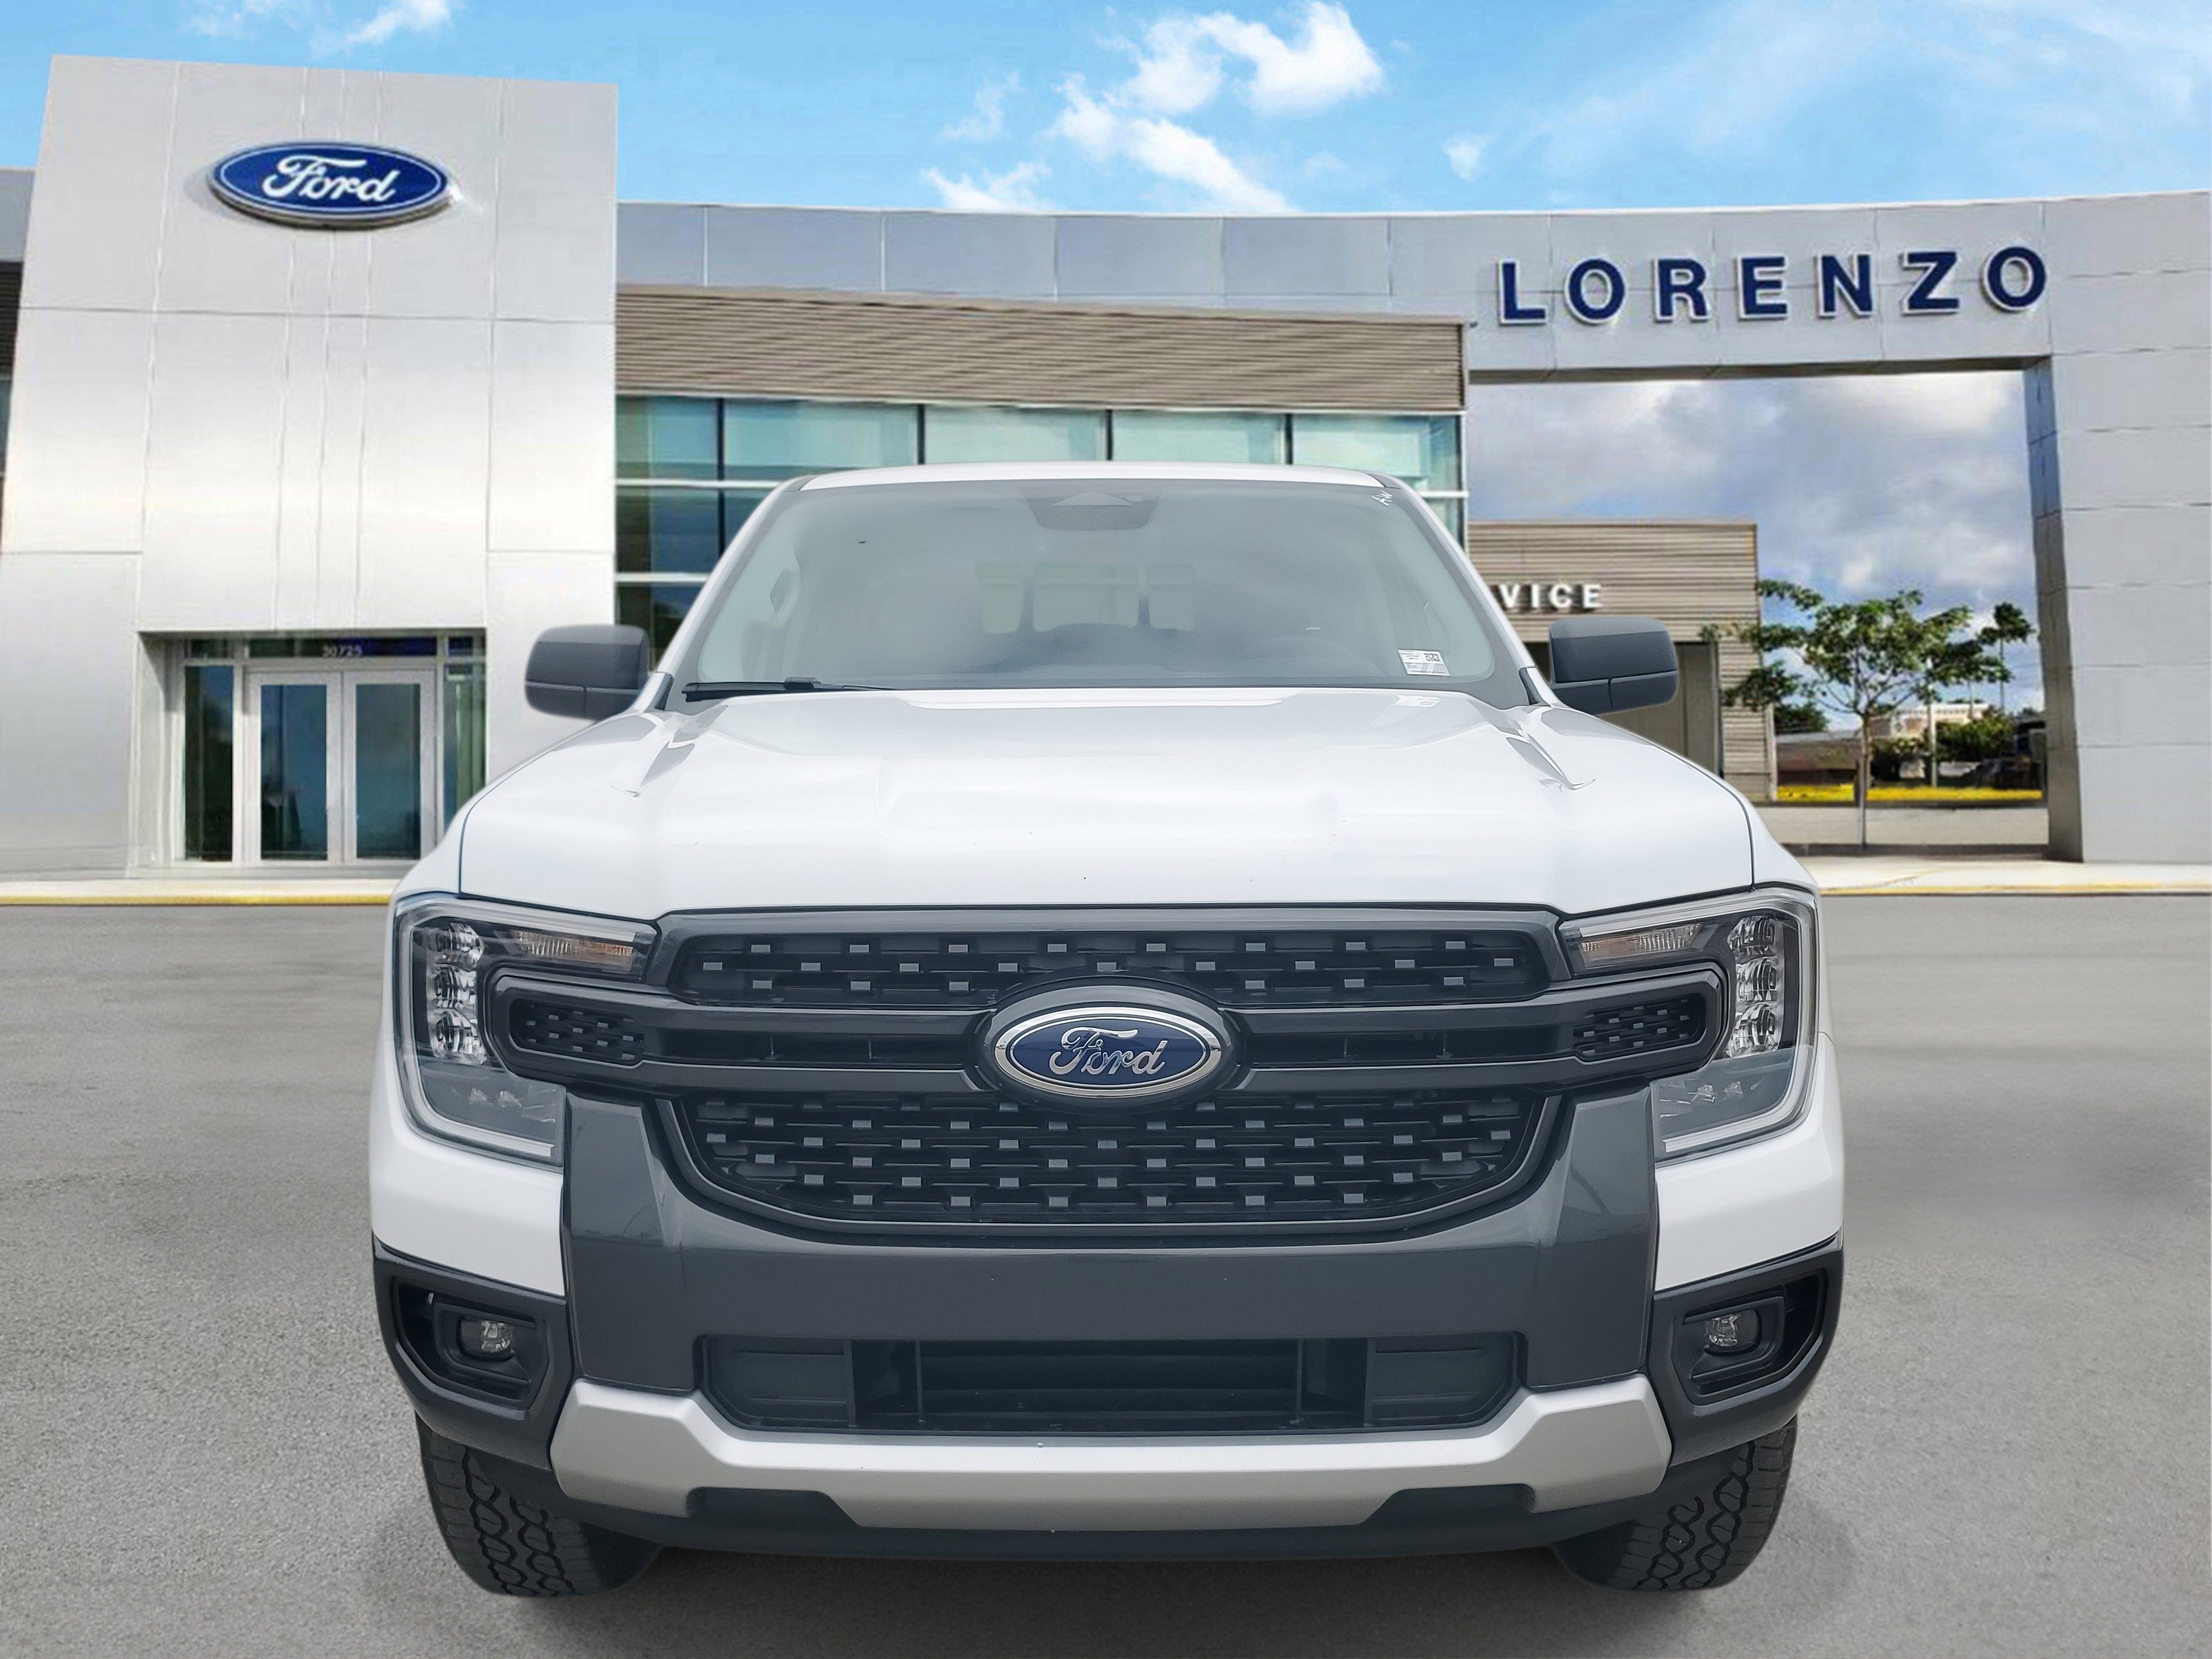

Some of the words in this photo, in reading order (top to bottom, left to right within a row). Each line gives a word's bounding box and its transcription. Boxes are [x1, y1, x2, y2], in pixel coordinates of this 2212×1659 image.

[263, 155, 401, 202] Ford
[1499, 246, 2046, 325] LORENZO
[1497, 582, 1603, 610] VICE
[1049, 1026, 1168, 1075] Ford
